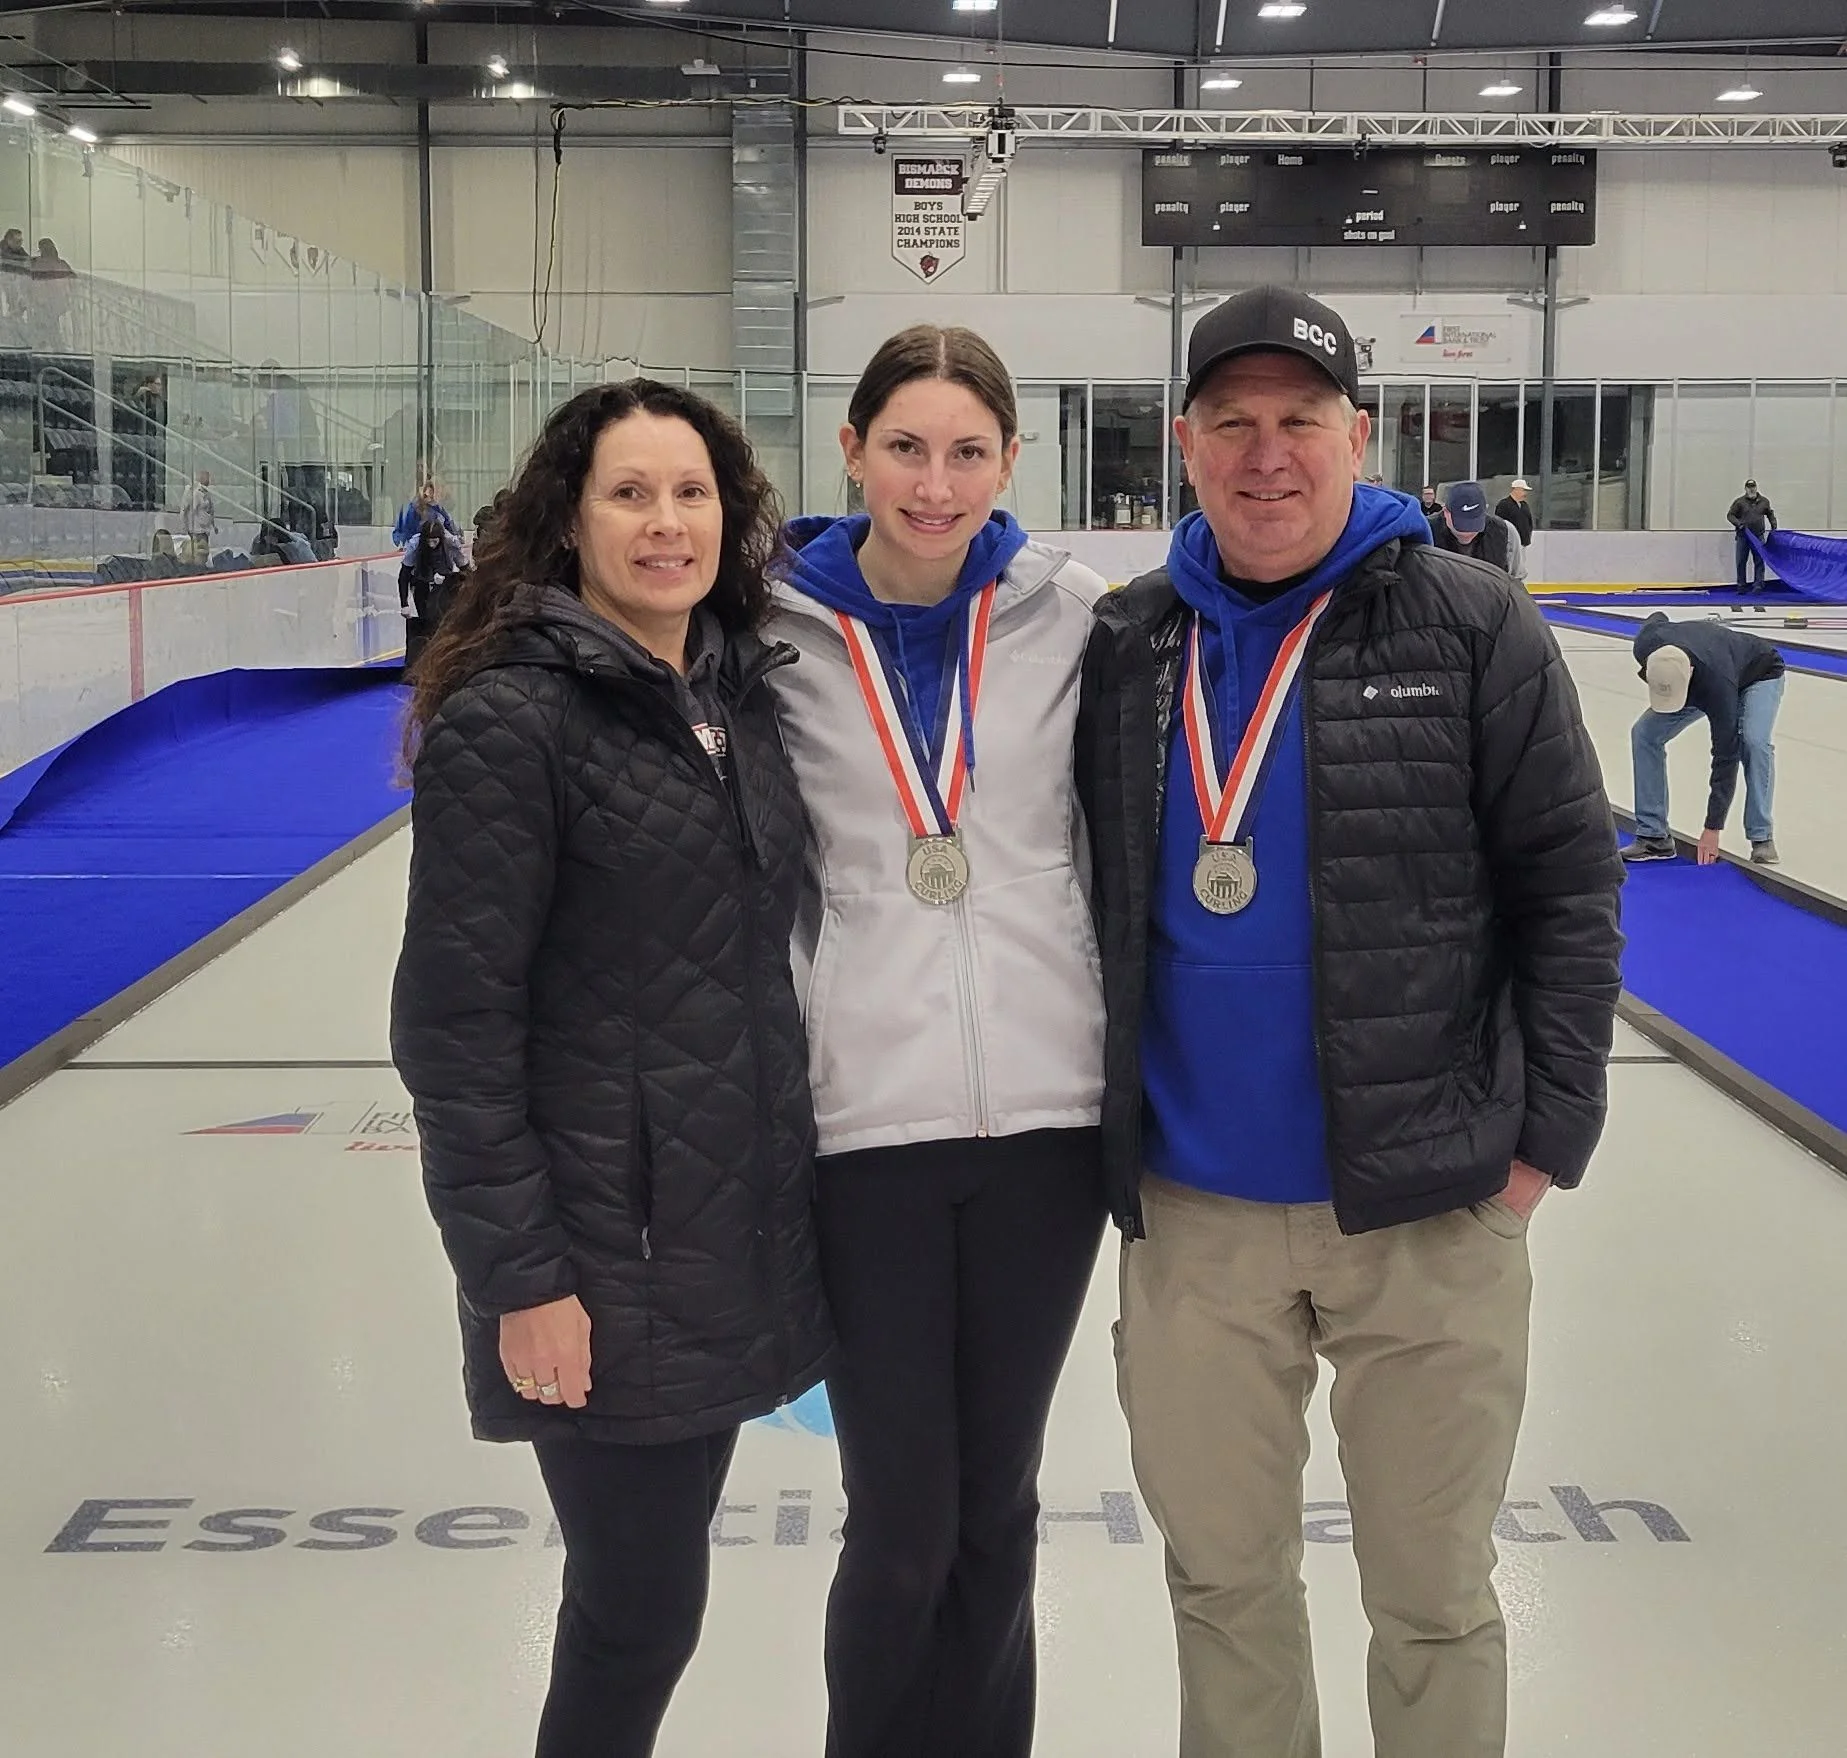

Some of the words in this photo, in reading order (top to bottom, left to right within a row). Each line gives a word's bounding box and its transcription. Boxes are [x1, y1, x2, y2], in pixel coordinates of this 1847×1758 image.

[1220, 154, 1250, 166] player
[1278, 154, 1303, 165] Home
[1490, 154, 1520, 165] player
[1551, 153, 1585, 165] penalty
[898, 164, 960, 175] BISMARCK
[904, 178, 952, 189] DEMONS
[913, 201, 943, 211] BOYS
[1154, 202, 1189, 214] penalty
[1219, 202, 1250, 214] player
[1489, 201, 1520, 213] player
[1550, 201, 1585, 214] penalty
[895, 213, 919, 223] HIGH
[922, 213, 962, 223] SCHOOL
[1355, 209, 1384, 222] period
[897, 226, 921, 236] 2014
[924, 226, 959, 236] STATE
[1343, 230, 1366, 240] shots
[896, 238, 960, 248] CHAMPIONS
[1293, 317, 1337, 356] BCC
[922, 844, 948, 856] USA
